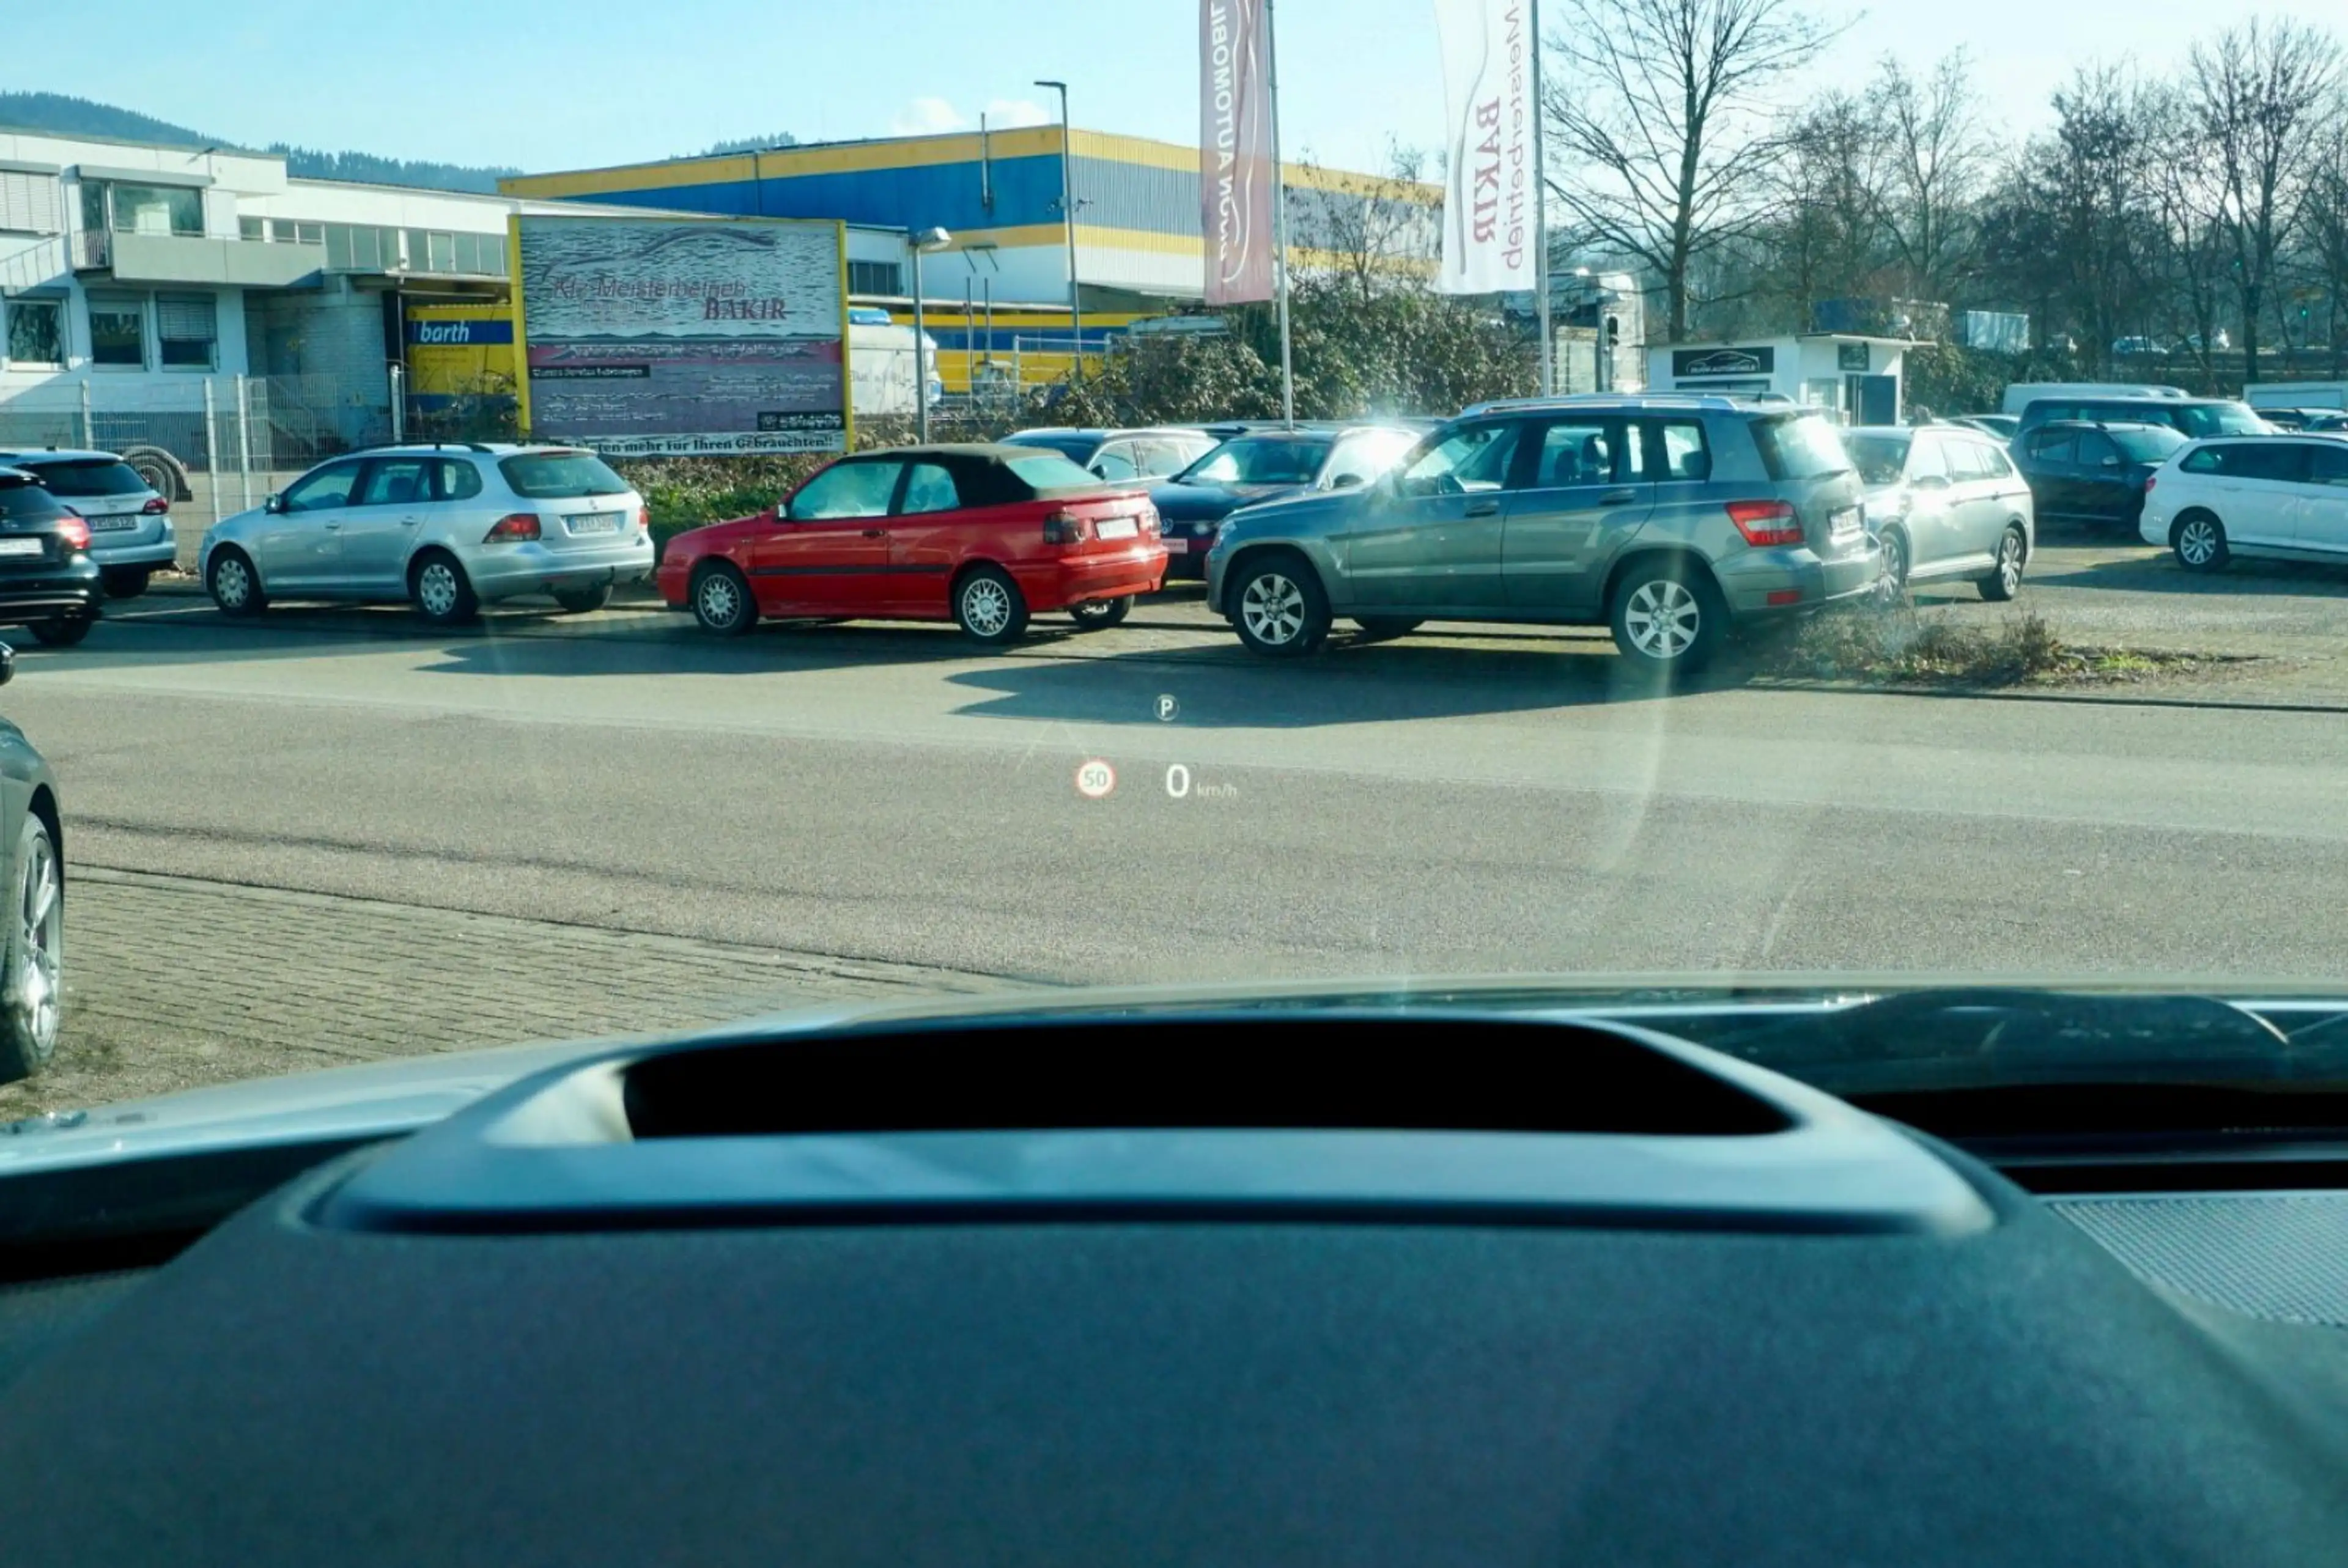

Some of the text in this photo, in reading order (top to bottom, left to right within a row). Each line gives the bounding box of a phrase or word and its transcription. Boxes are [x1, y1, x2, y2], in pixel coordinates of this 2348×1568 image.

[704, 296, 787, 320] BAKIR
[420, 320, 470, 343] barth
[624, 440, 663, 452] mehr
[693, 438, 732, 451] Ihren
[1084, 770, 1108, 787] 50
[1165, 763, 1238, 798] 0 km/h
